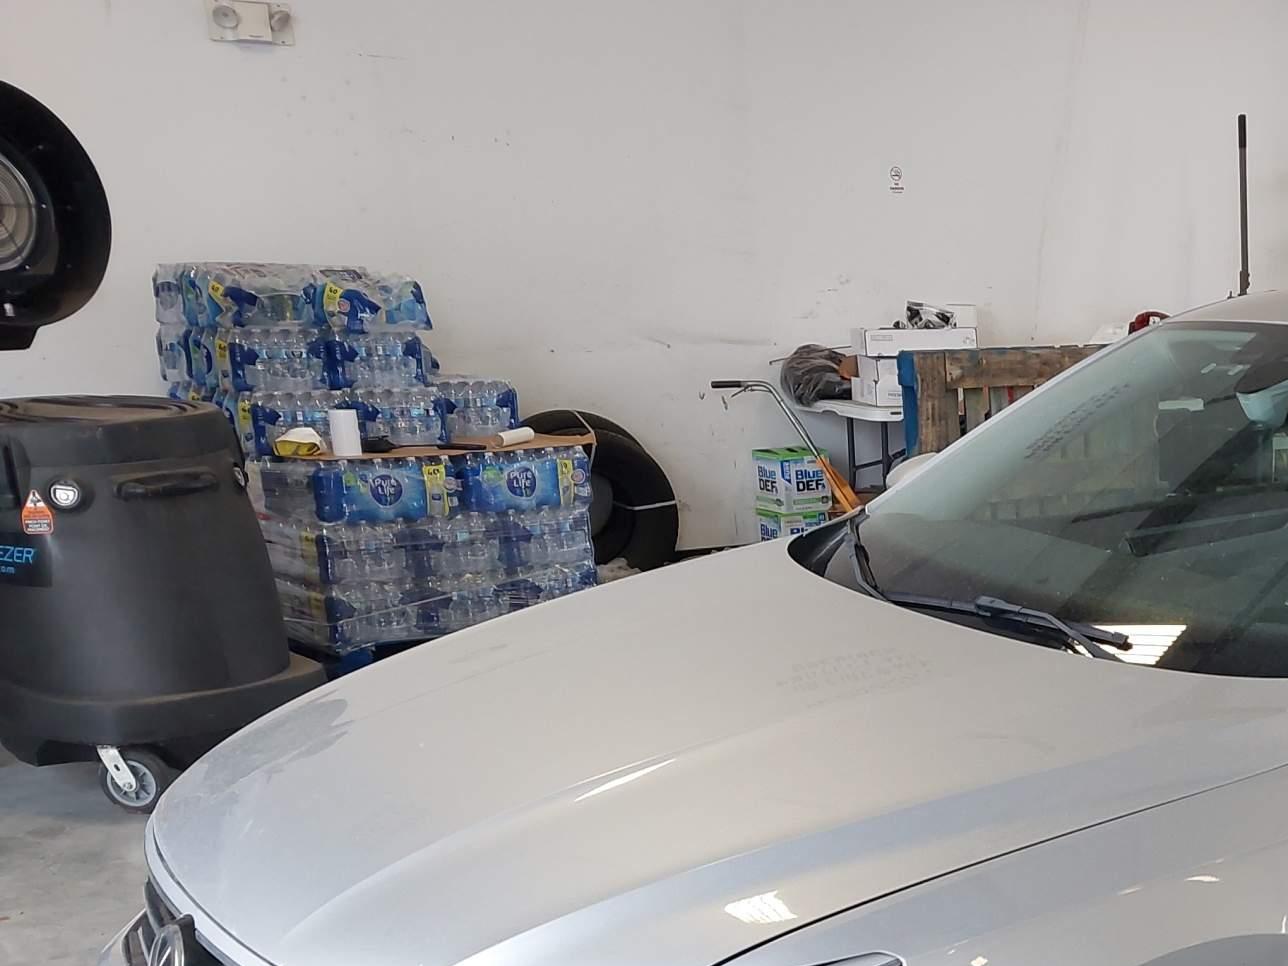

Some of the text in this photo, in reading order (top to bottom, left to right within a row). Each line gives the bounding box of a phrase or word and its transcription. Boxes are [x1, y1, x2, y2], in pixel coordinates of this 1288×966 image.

[510, 470, 532, 479] Pure
[757, 465, 776, 480] Blue
[795, 469, 824, 480] Blue
[513, 478, 531, 489] Life
[758, 478, 778, 494] DEF
[796, 478, 826, 492] DEF
[760, 523, 778, 539] Blue
